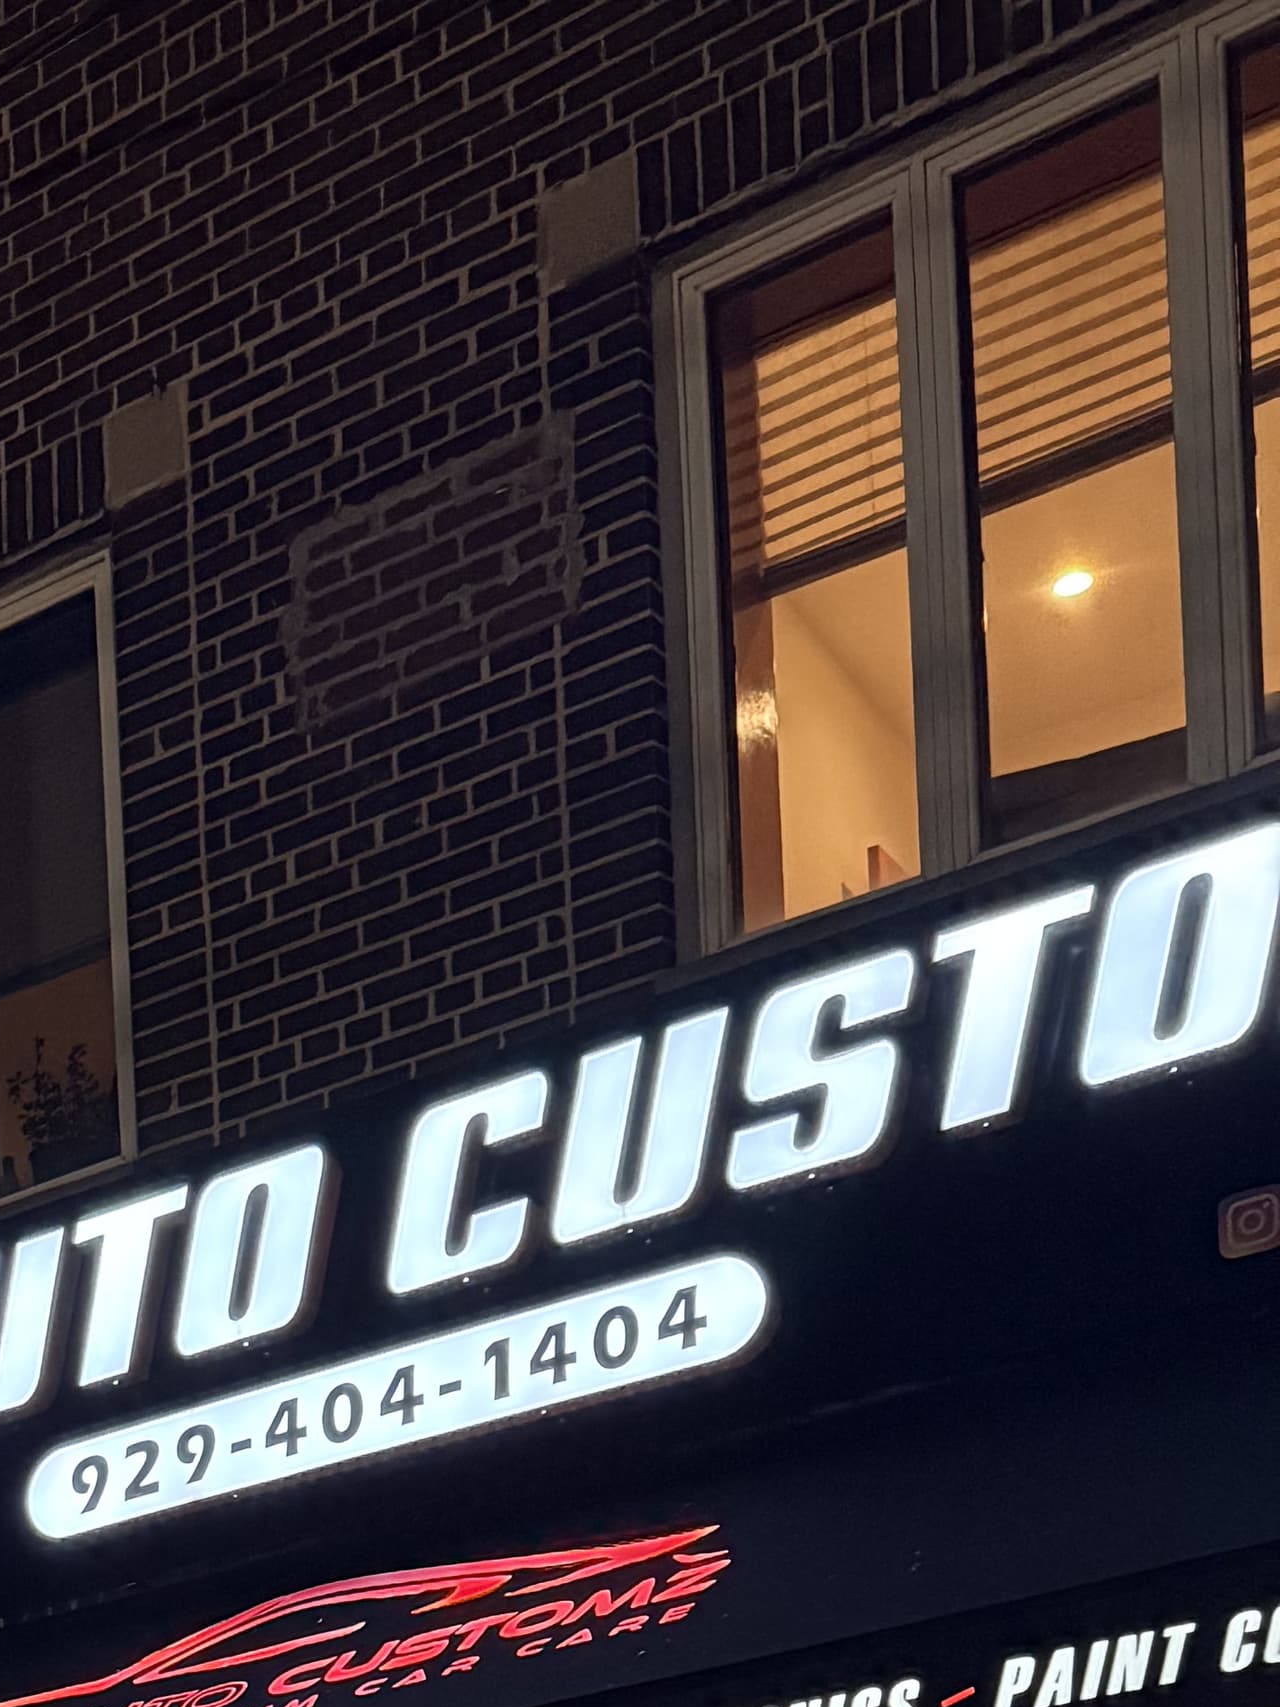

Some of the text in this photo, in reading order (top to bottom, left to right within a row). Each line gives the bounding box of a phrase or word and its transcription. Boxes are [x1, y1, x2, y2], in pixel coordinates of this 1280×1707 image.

[387, 821, 1280, 1296] CUSTO
[69, 1284, 708, 1514] 929-404-1404
[267, 1559, 733, 1695] CUSTOMZ
[356, 1656, 473, 1697] CAR
[517, 1602, 697, 1657] CARE
